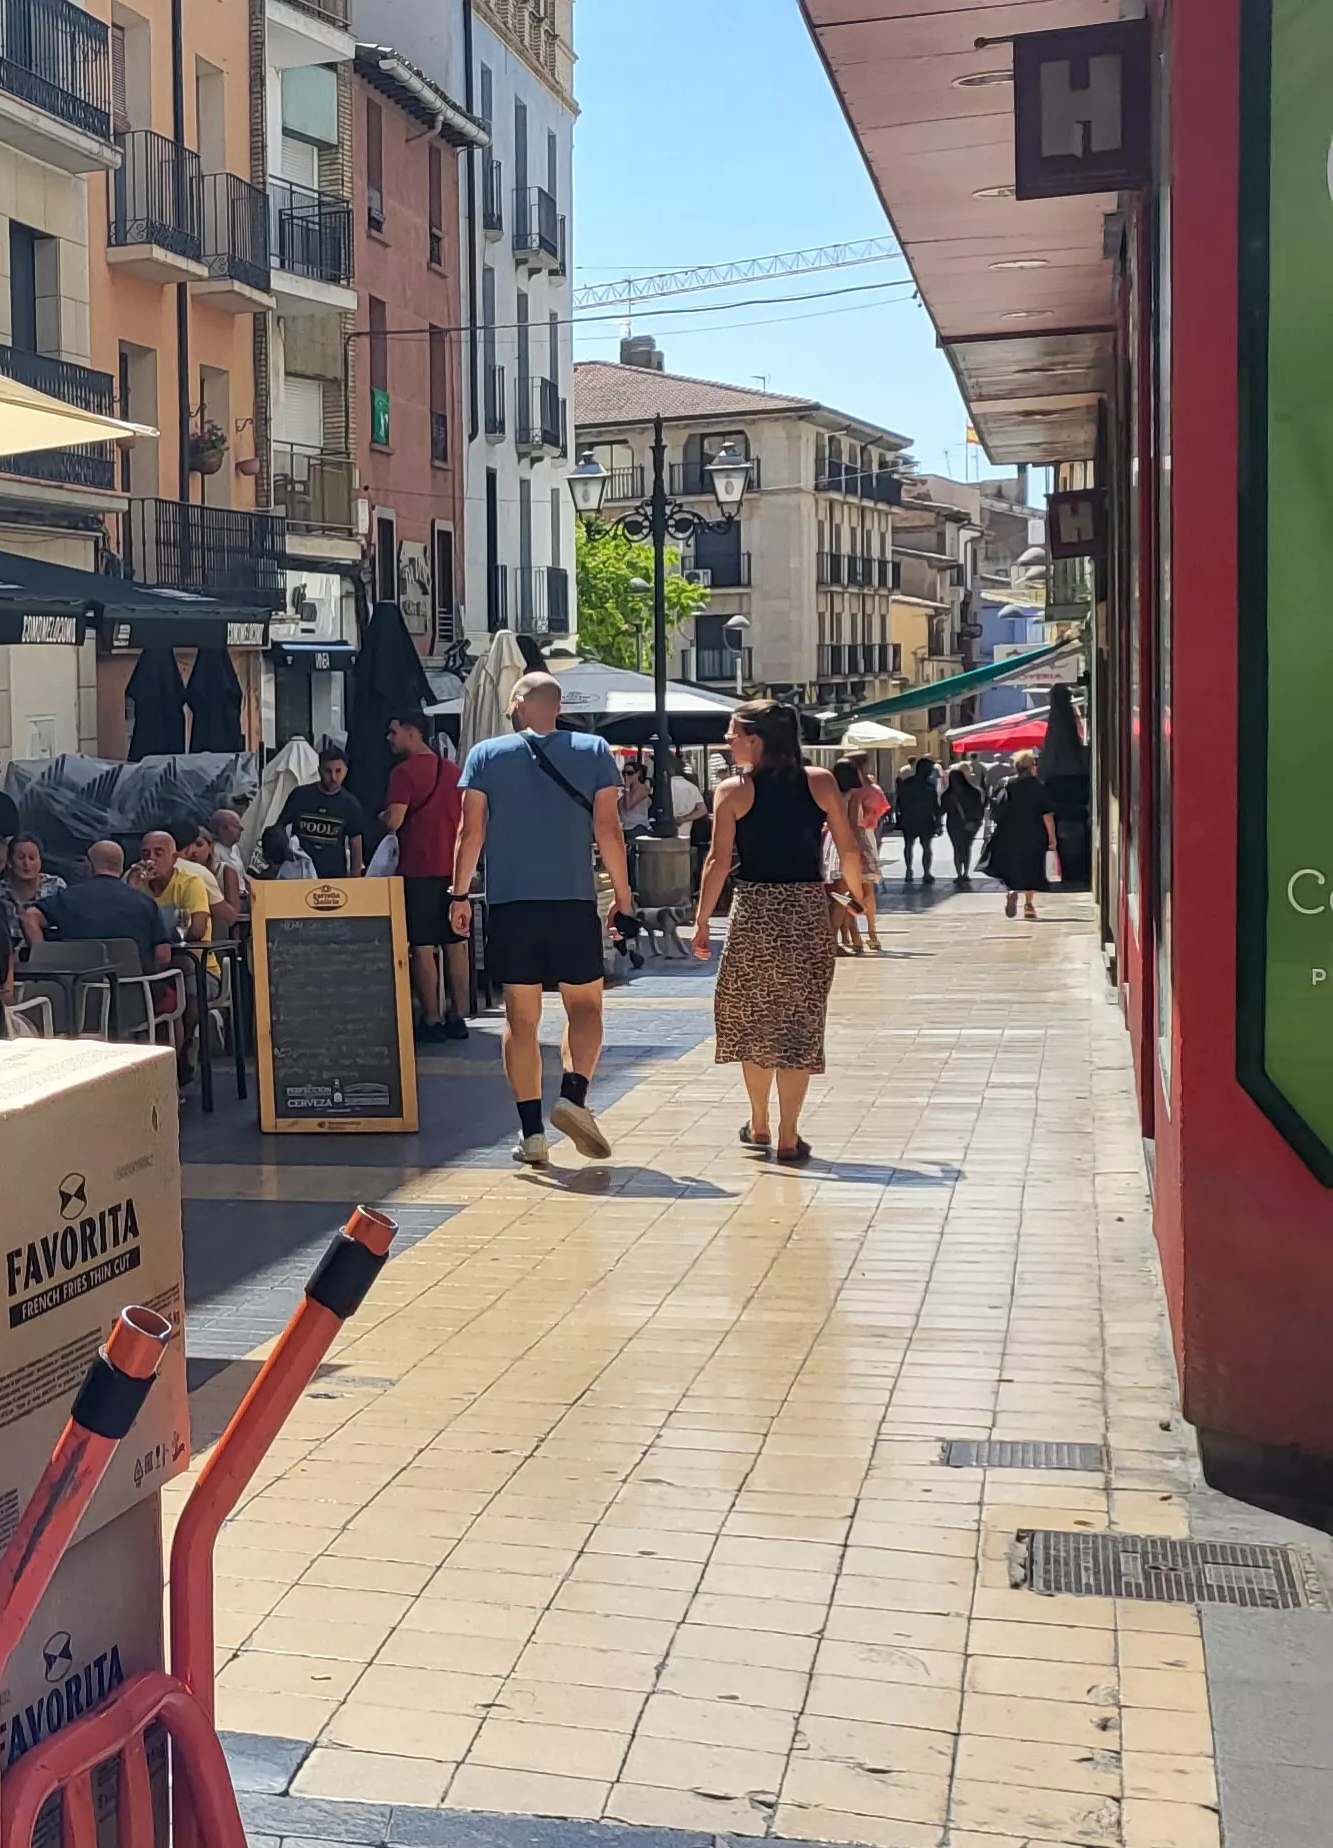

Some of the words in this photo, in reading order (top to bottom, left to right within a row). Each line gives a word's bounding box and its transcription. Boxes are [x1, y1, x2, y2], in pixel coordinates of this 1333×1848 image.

[1039, 53, 1123, 159] H
[1287, 868, 1333, 915] C
[7, 1197, 140, 1297] FAVORITA
[21, 1287, 60, 1320] FRENCH
[62, 1275, 88, 1300] FRIES
[89, 1265, 112, 1286] THIN
[113, 1253, 131, 1274] CUT
